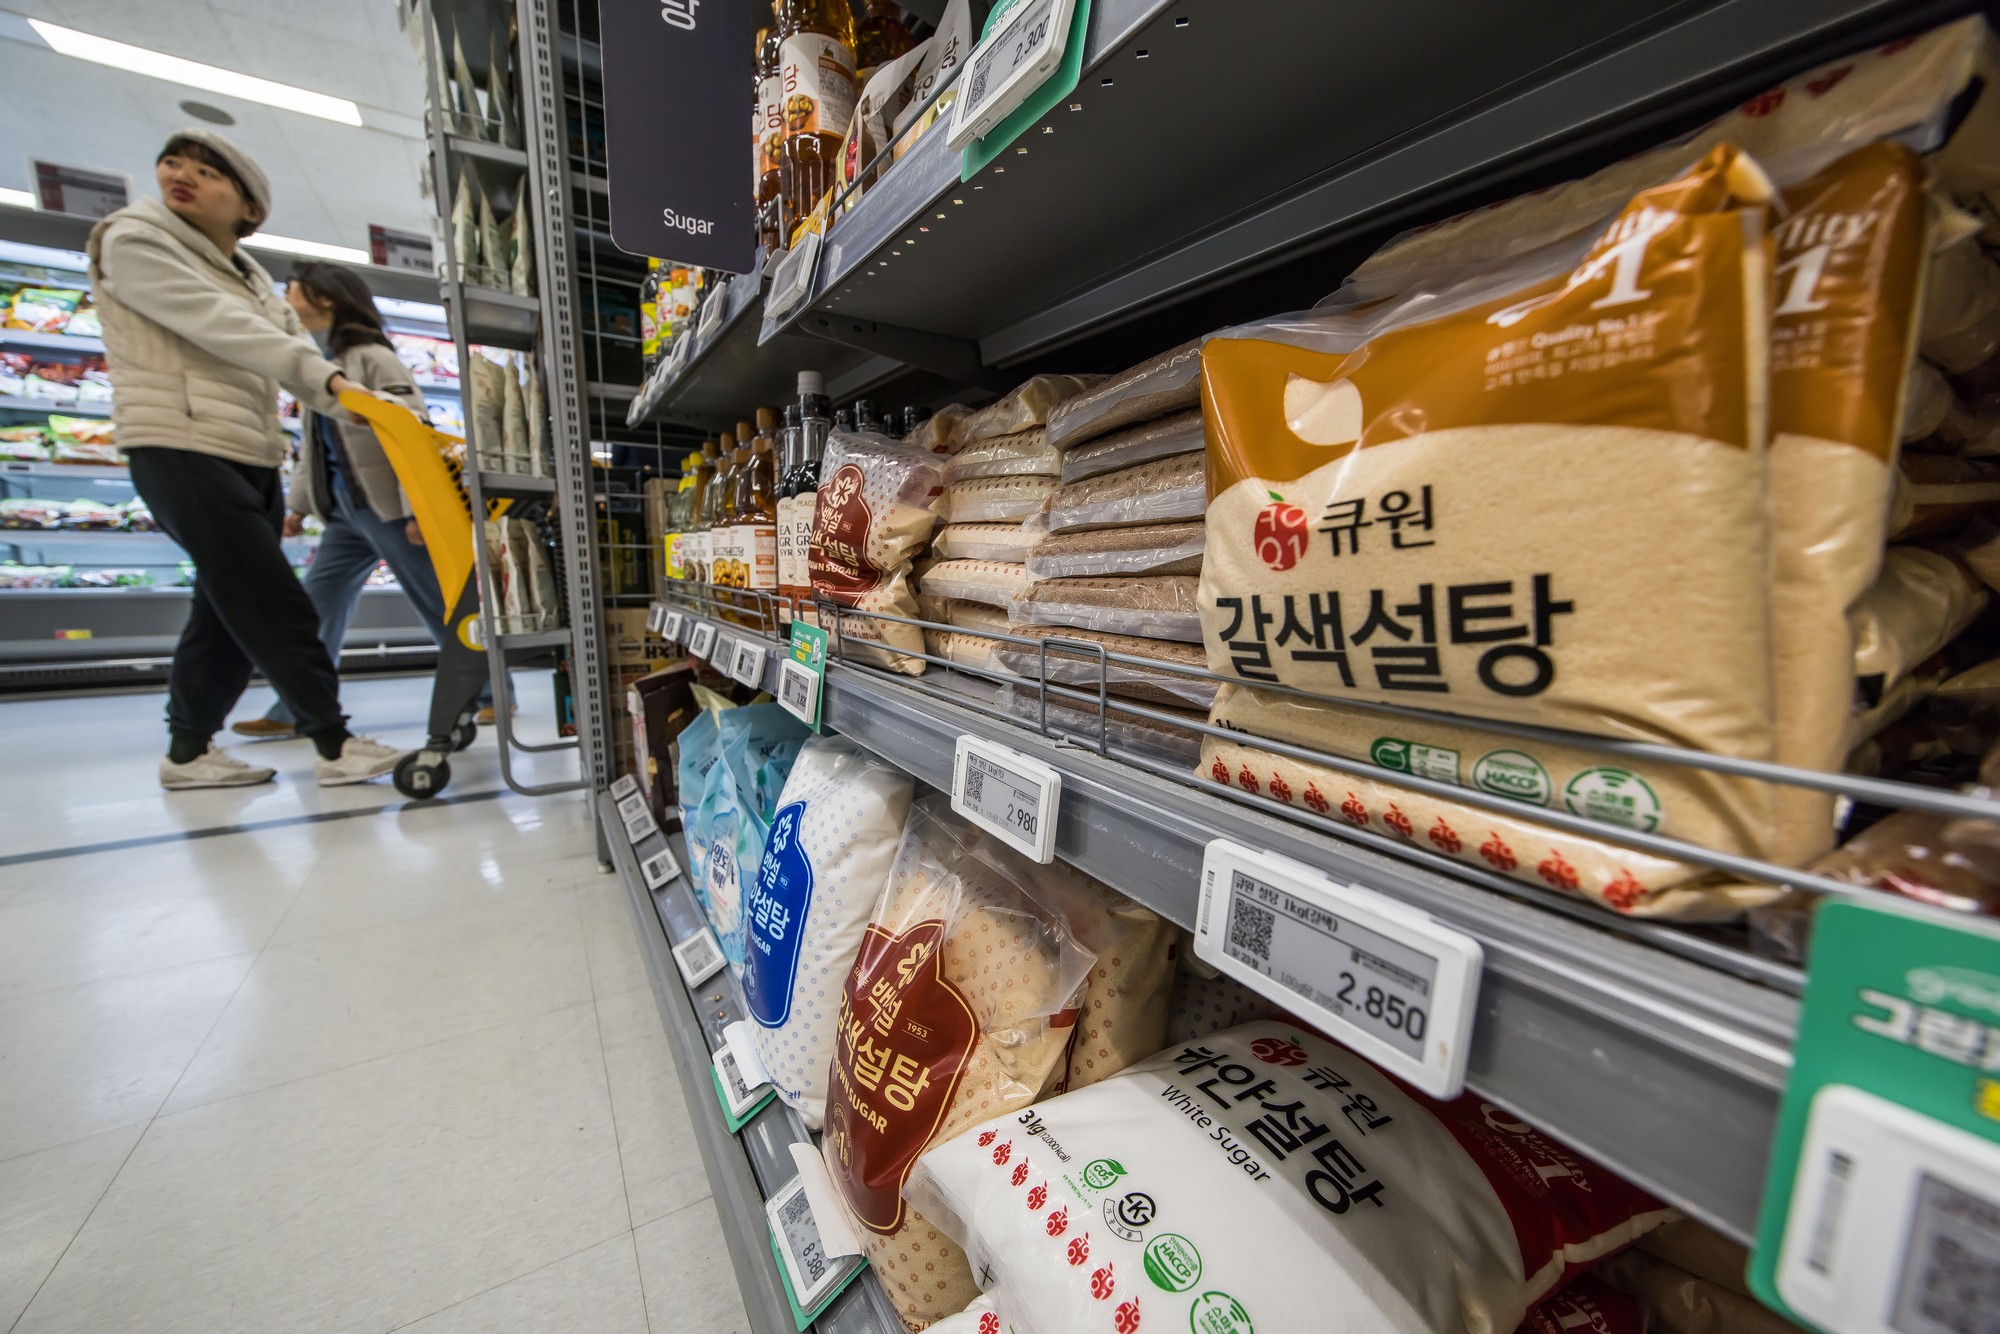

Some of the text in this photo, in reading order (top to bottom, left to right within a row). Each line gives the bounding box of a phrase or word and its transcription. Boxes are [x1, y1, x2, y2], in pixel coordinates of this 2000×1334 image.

[663, 208, 715, 235] Sugar
[821, 505, 842, 535] 백설
[1318, 485, 1436, 556] 큐원
[826, 562, 859, 577] SUGAR
[1216, 573, 1575, 697] 갈색설탕
[1485, 769, 1541, 790] HACCP
[1007, 804, 1038, 835] 2.980
[763, 850, 781, 890] 백설
[1236, 875, 1255, 894] 큐원
[868, 977, 902, 1037] 백설
[1337, 971, 1427, 1041] 2.850
[907, 1022, 928, 1038] 1953
[848, 1087, 888, 1134] SUGAR
[1302, 1066, 1394, 1136] 큐원
[1161, 1084, 1271, 1182] White Sugar
[1173, 1046, 1386, 1215] 하얀설탕
[1493, 1135, 1524, 1165] Quality
[803, 1242, 825, 1282] 8.380
[1159, 1242, 1191, 1277] HACCP
